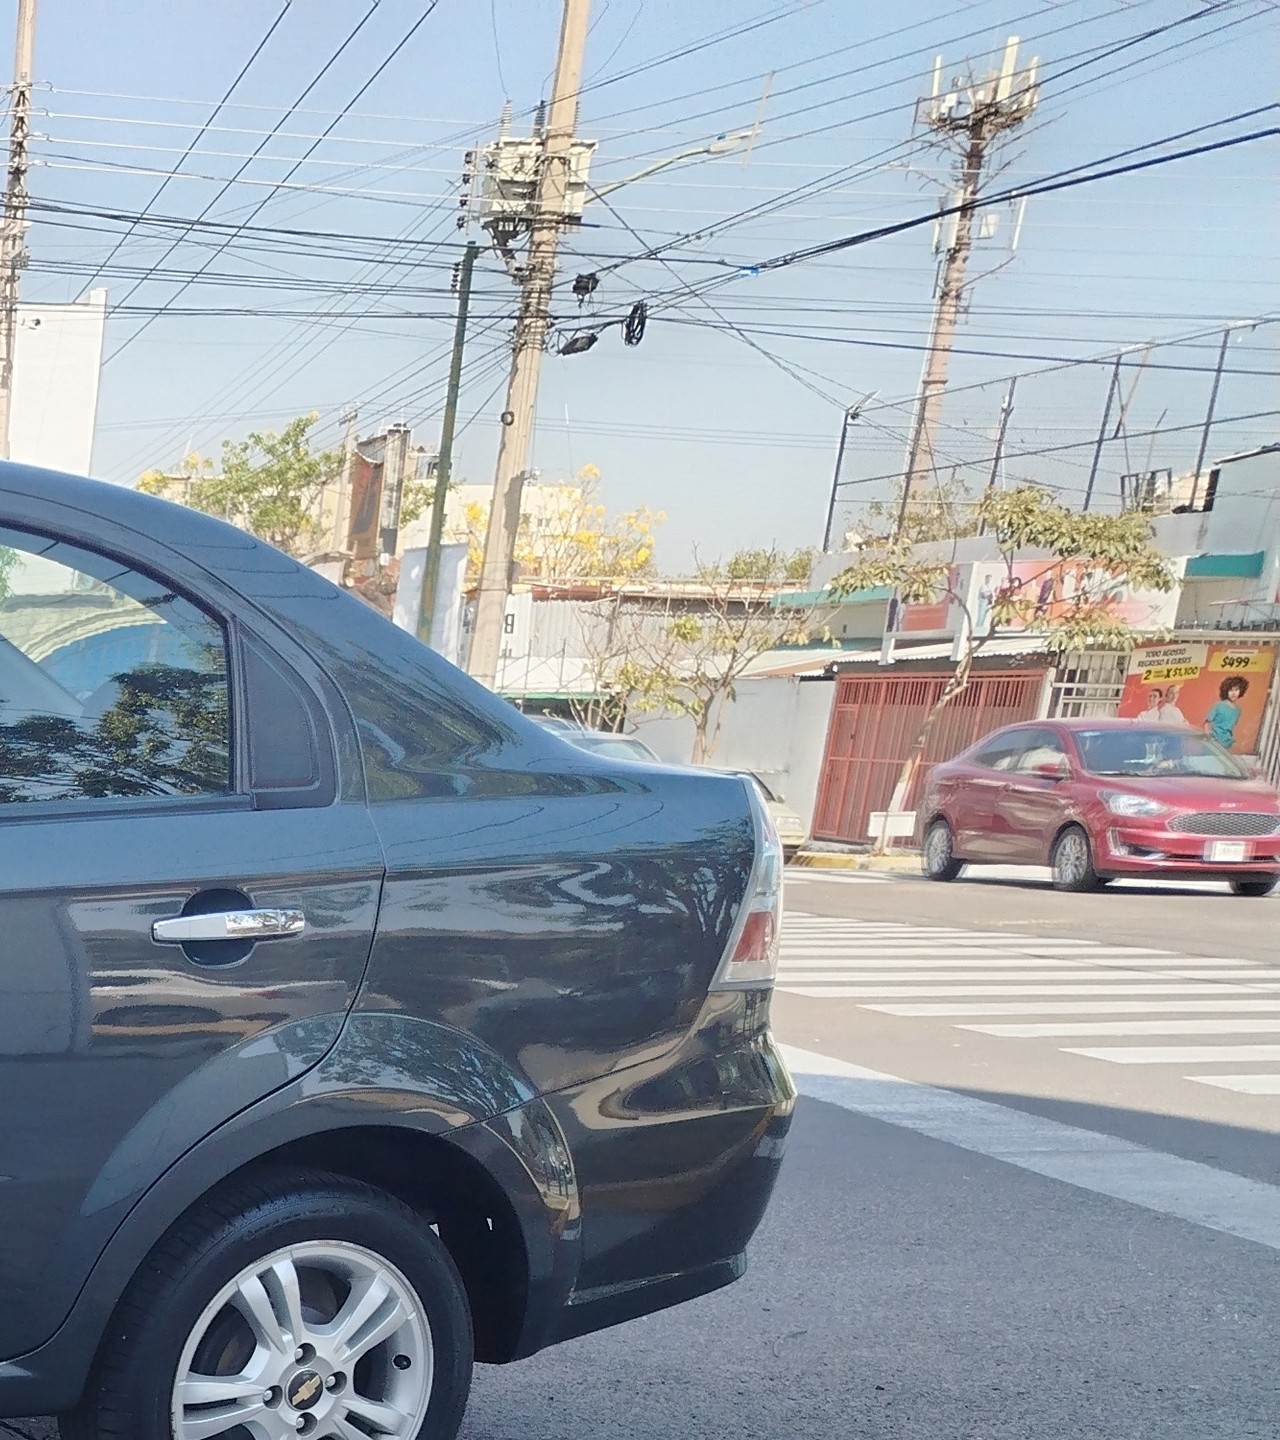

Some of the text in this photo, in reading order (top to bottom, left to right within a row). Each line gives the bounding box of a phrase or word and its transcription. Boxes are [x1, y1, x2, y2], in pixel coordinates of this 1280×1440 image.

[1162, 648, 1187, 657] AGOSTO
[1137, 659, 1165, 668] REGRESO
[1220, 656, 1251, 668] $499
[1143, 669, 1152, 680] 2
